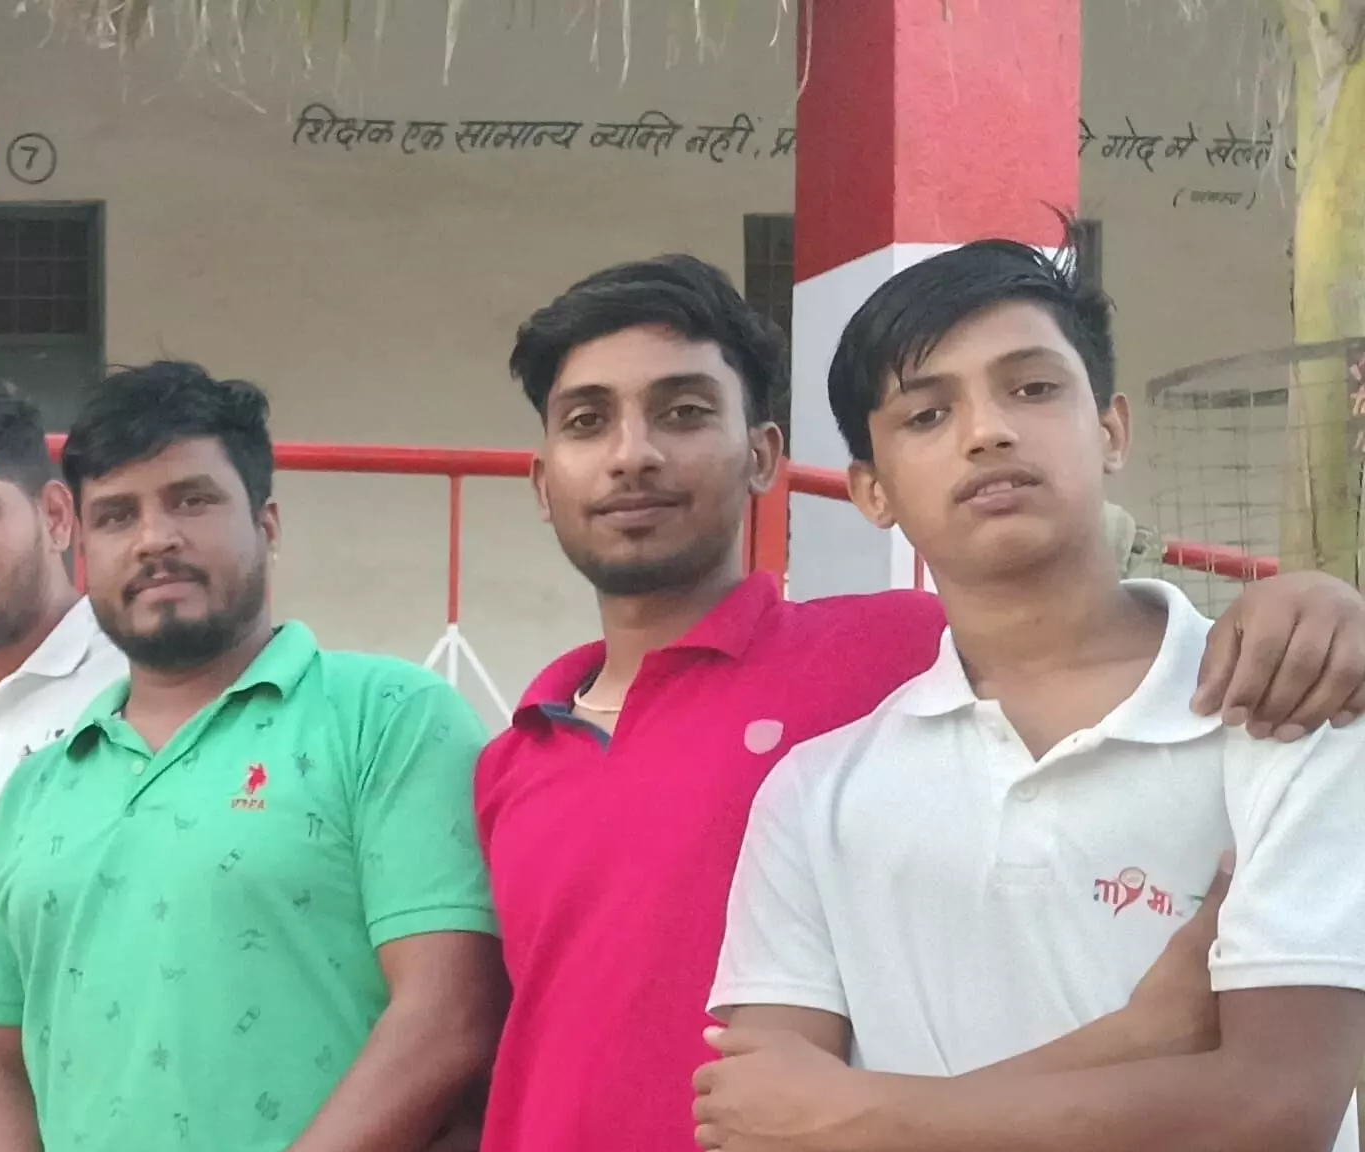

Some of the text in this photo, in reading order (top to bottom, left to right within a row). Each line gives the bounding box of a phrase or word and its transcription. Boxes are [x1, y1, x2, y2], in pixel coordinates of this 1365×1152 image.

[293, 103, 396, 151] शिक्षक
[401, 121, 449, 154] एक
[455, 120, 584, 152] सामान्य
[589, 110, 684, 157] व्यक्ति
[1102, 116, 1163, 172] गोद
